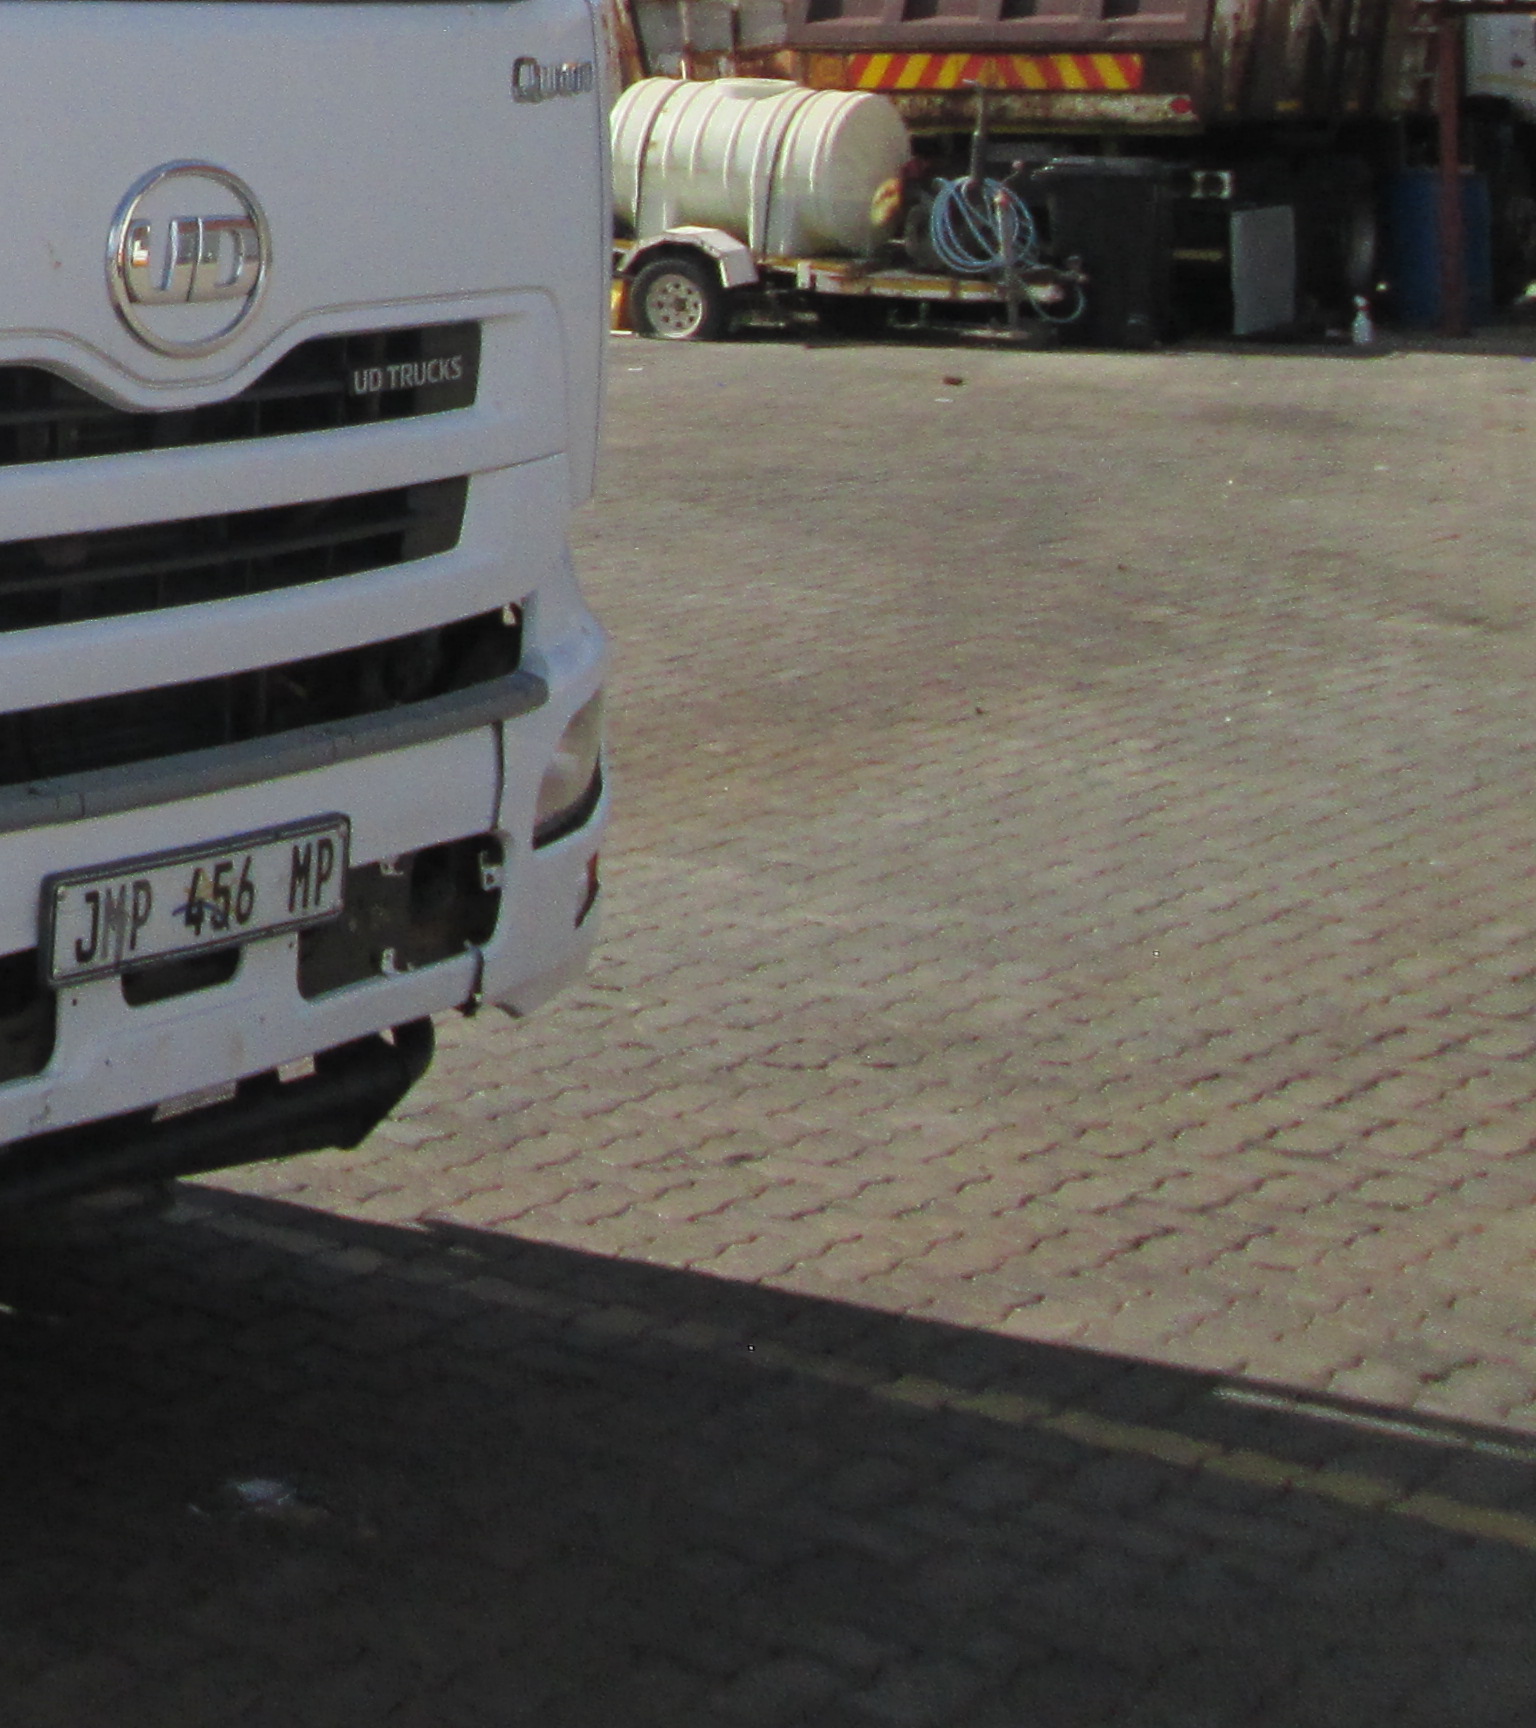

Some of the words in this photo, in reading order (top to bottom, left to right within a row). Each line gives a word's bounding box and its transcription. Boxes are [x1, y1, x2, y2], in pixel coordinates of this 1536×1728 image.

[353, 366, 382, 395] UD
[386, 355, 464, 389] TRUCKS
[74, 878, 153, 965] JMP
[183, 855, 255, 936] 456
[288, 837, 335, 914] MP
